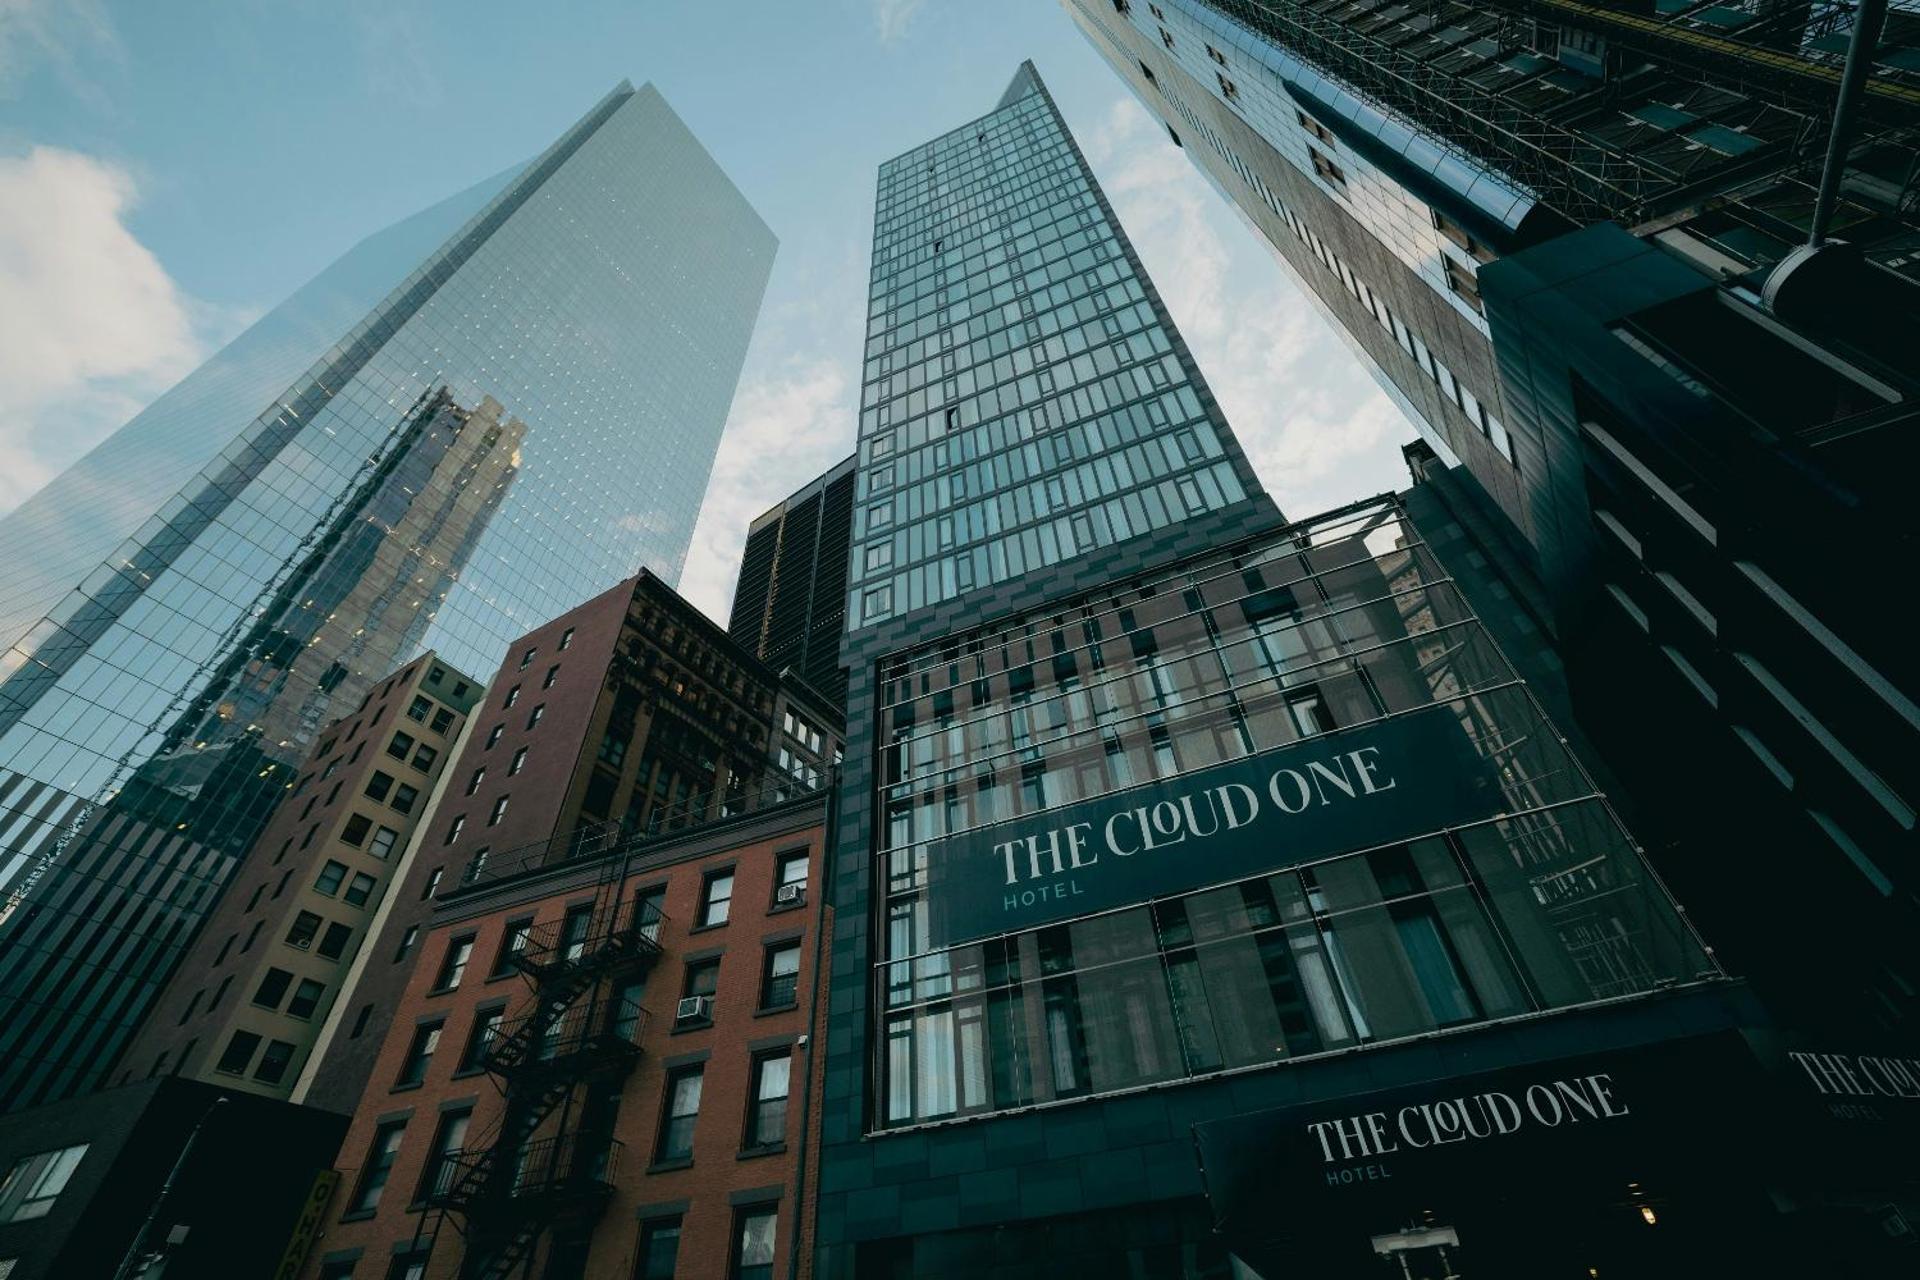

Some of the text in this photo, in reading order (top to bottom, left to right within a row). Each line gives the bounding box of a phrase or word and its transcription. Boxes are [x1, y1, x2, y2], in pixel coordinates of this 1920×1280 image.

[993, 745, 1396, 886] THE CLOUD ONE
[1003, 880, 1084, 912] HOTEL
[1788, 1052, 1874, 1095] THE
[1307, 1073, 1629, 1162] THE CLOUD ONE
[1326, 1164, 1392, 1187] HOTEL
